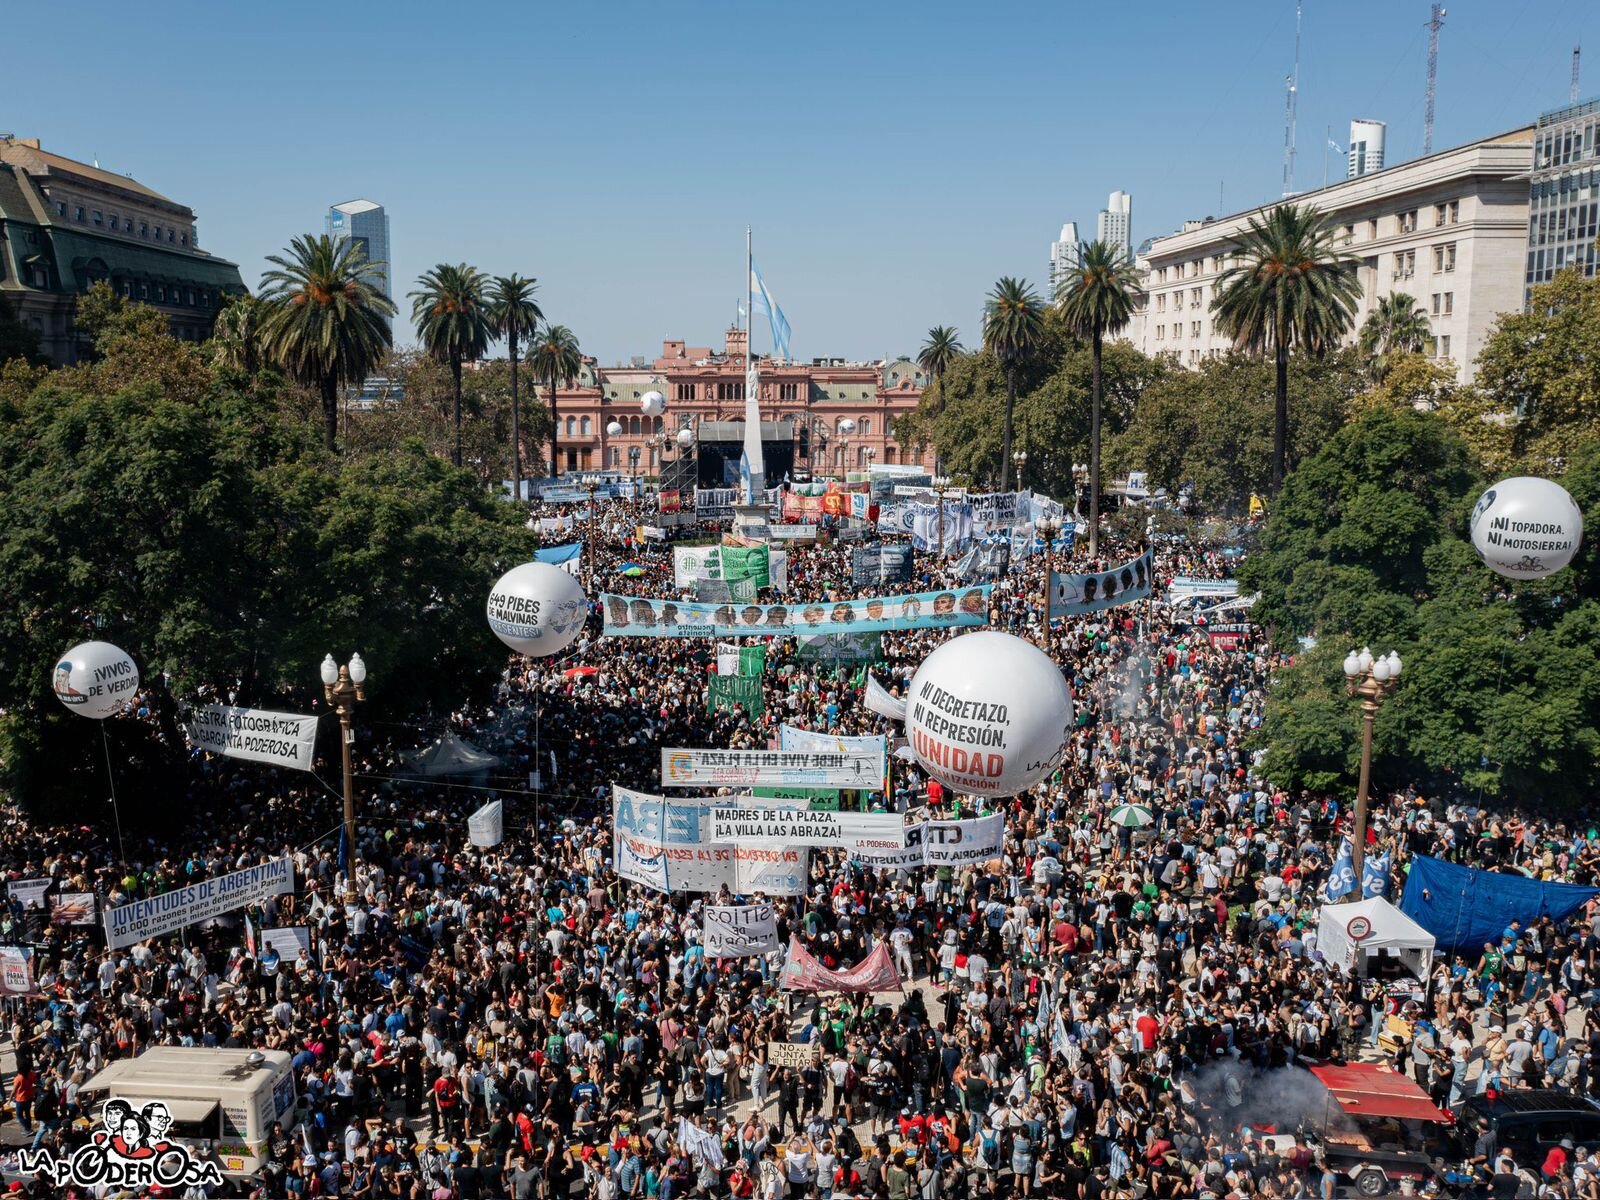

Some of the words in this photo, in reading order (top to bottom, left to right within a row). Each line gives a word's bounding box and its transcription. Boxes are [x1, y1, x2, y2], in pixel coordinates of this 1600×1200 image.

[1490, 517, 1509, 531] ¡NI
[1512, 521, 1565, 535] TOPADORA.
[1488, 531, 1502, 546] NI
[1503, 538, 1572, 551] MOTOSIERRA!
[507, 596, 540, 614] PIBES
[488, 607, 495, 617] DE
[496, 610, 538, 626] MALVINAS
[94, 660, 131, 682] ¡VIVOS
[88, 686, 104, 697] DE
[920, 680, 934, 701] NI
[932, 688, 1010, 726] DECRETAZO,
[229, 714, 300, 737] FOTOGRÁFICA
[914, 702, 924, 723] NI
[925, 710, 1007, 750] REPRESIÓN,
[200, 729, 243, 750] GARGANTA
[245, 736, 298, 760] PODEROSA
[912, 726, 1004, 778] ¡UNIDAD
[1026, 760, 1041, 772] LA
[715, 810, 760, 822] MADRES
[763, 810, 776, 822] DE
[779, 810, 794, 822] LA
[796, 812, 837, 823] PLAZA.
[715, 825, 732, 838] ¡LA
[735, 825, 764, 837] VILLA
[767, 825, 787, 837] LAS
[790, 825, 842, 838] ABRAZA!
[856, 839, 865, 848] LA
[866, 840, 900, 849] PODEROSA
[112, 887, 196, 928] JUVENTUDES
[199, 880, 215, 900] DE
[218, 860, 286, 894] ARGENTINA
[114, 918, 149, 937] 30.000
[152, 907, 187, 925] razones
[190, 901, 210, 914] para
[212, 887, 248, 906] defender
[250, 884, 258, 892] la
[260, 876, 287, 889] Patria
[170, 915, 187, 928] más
[190, 904, 223, 921] miseria
[774, 1050, 806, 1058] JUNTA
[779, 1044, 794, 1052] NO
